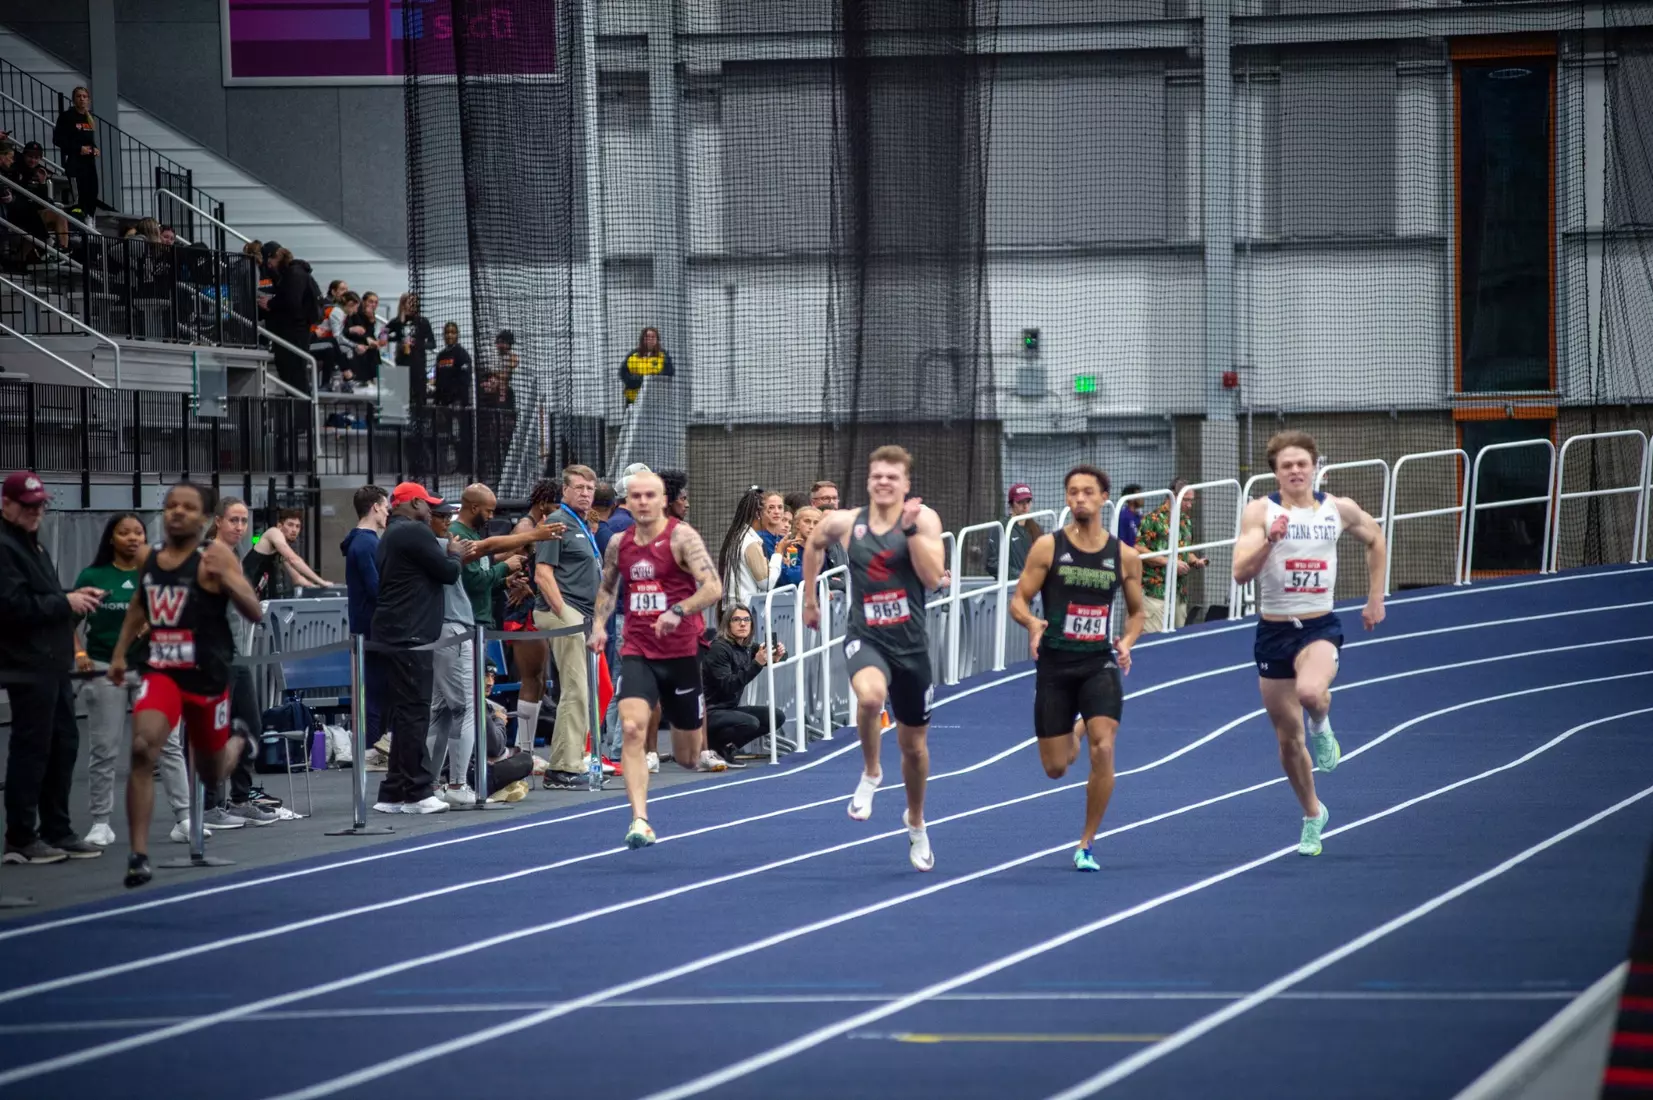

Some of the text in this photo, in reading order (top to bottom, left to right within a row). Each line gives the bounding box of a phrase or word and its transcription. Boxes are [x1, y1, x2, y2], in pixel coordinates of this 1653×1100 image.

[1314, 526, 1336, 541] STATE
[1292, 571, 1321, 588] 571
[145, 584, 189, 627] W
[636, 593, 658, 610] 191
[873, 601, 903, 619] 869
[1073, 617, 1102, 635] 649
